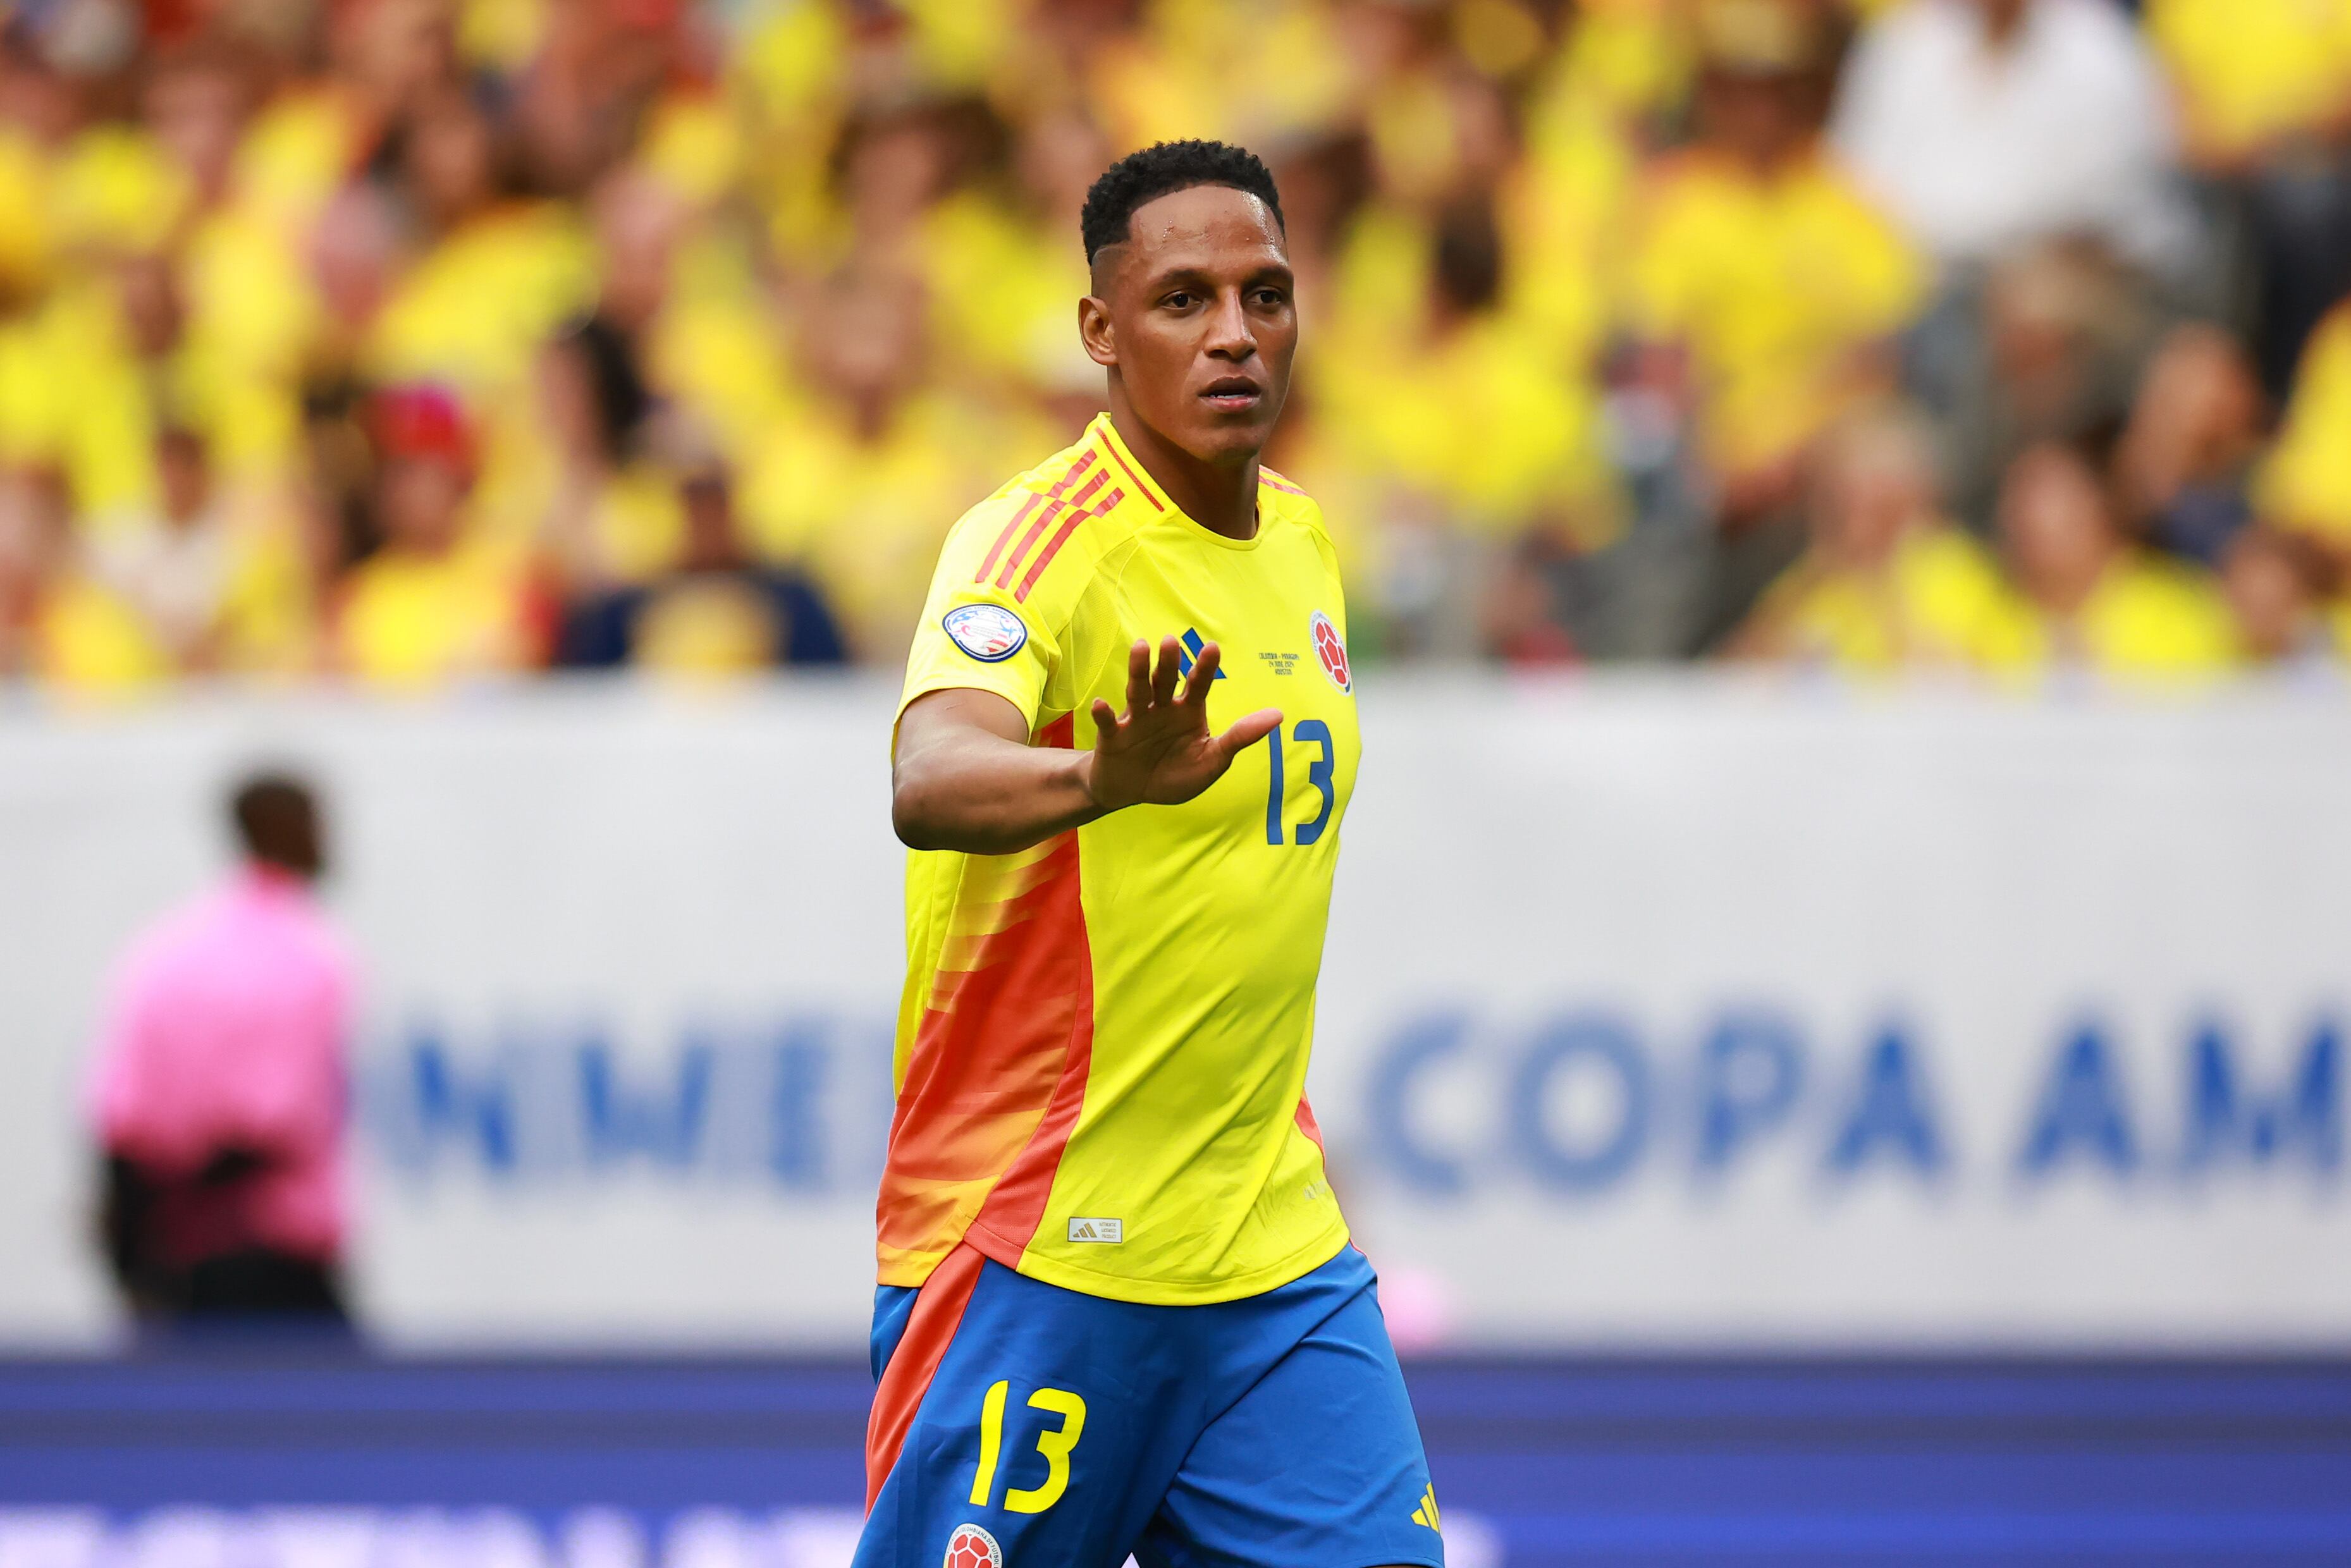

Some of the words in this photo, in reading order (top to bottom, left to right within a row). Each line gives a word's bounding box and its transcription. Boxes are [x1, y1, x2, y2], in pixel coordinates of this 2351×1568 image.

[1266, 719, 1334, 845] 13
[1360, 999, 1948, 1204] COPA
[969, 1380, 1087, 1514] 13
